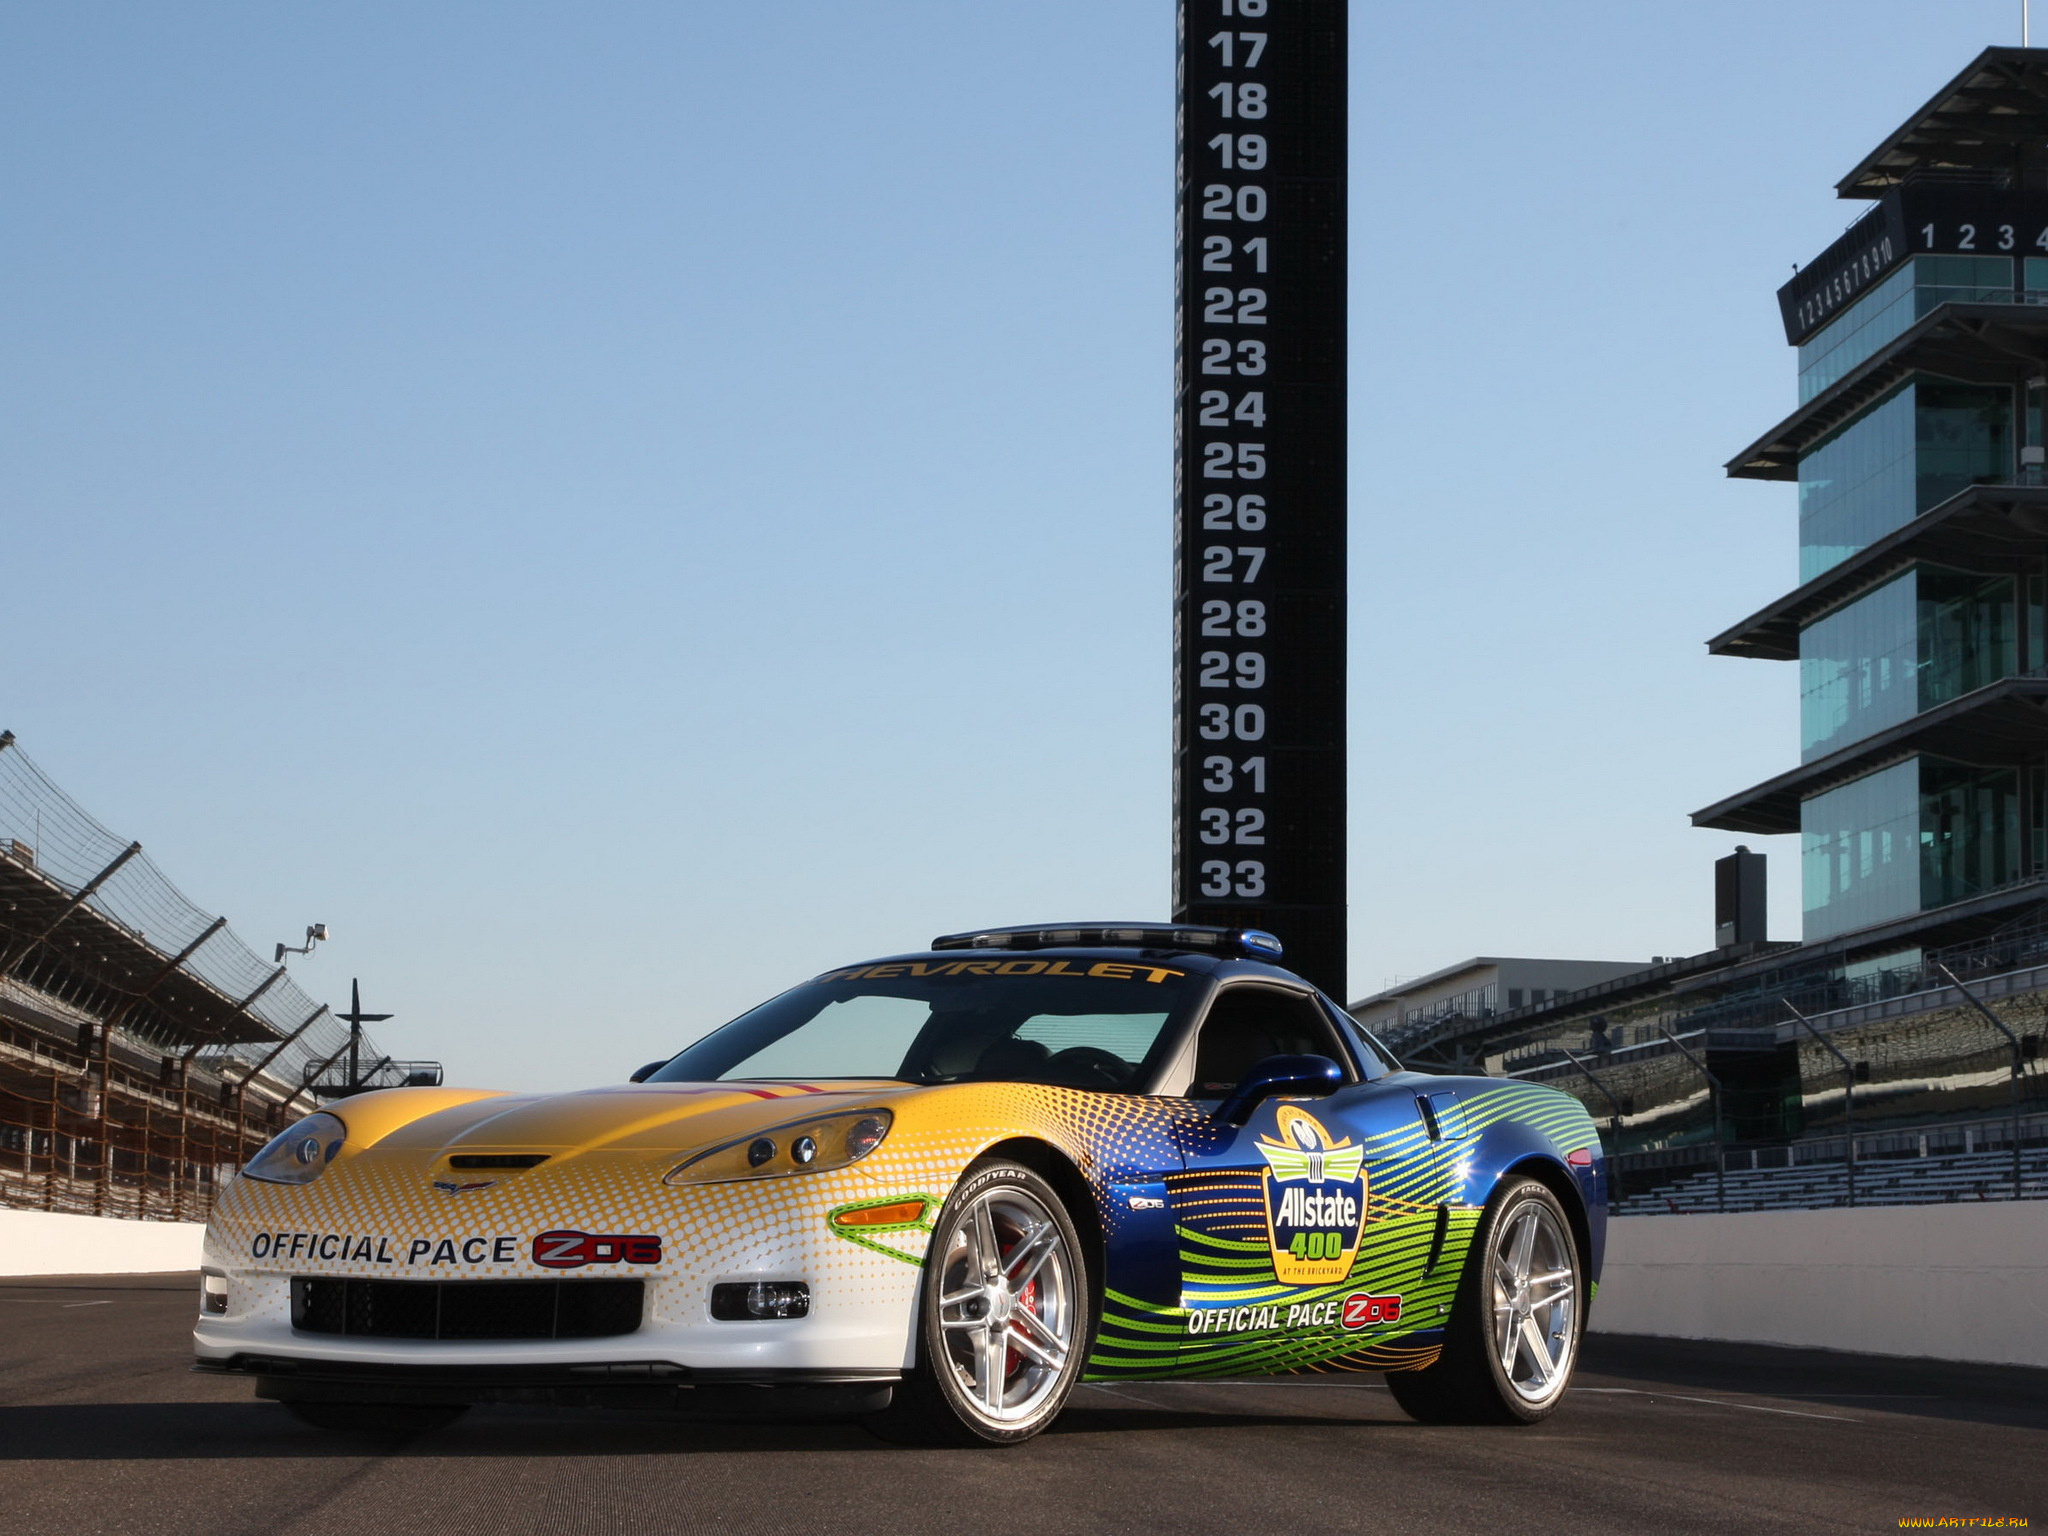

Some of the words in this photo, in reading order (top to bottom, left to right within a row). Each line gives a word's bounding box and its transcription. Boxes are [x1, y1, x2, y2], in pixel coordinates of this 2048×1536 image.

[1208, 31, 1268, 68] 17
[1208, 82, 1268, 119] 18
[1208, 133, 1268, 170] 19
[1203, 184, 1267, 221] 20
[1203, 235, 1267, 272] 21
[1921, 223, 1934, 249] 1
[1958, 224, 1976, 249] 2
[1998, 224, 2014, 250] 3
[1799, 307, 1805, 330] 1
[1807, 301, 1814, 324] 2
[1816, 293, 1823, 316] 3
[1826, 285, 1832, 309] 4
[1834, 278, 1842, 302] 5
[1843, 270, 1851, 294] 6
[1852, 262, 1859, 287] 7
[1862, 254, 1870, 279] 8
[1872, 246, 1880, 271] 9
[1881, 236, 1892, 264] 10
[1204, 287, 1267, 324] 22
[1202, 339, 1267, 376] 23
[1200, 390, 1266, 427] 24
[1203, 442, 1266, 479] 25
[1203, 493, 1266, 531] 26
[1203, 546, 1266, 583] 27
[1201, 600, 1266, 637] 28
[1200, 651, 1266, 688] 29
[1200, 703, 1266, 740] 30
[1203, 755, 1265, 792] 31
[1200, 807, 1265, 844] 32
[1201, 860, 1265, 897] 33
[812, 961, 1185, 984] HEVROLET
[954, 1170, 1027, 1211] GOODYEAR
[1276, 1187, 1356, 1228] Allstate
[252, 1232, 394, 1263] OFFICIAL
[408, 1236, 518, 1265] PACE
[536, 1231, 662, 1266] Z06
[1288, 1232, 1343, 1261] 400
[1188, 1305, 1279, 1334] OFFICIAL
[1286, 1301, 1338, 1328] PACE
[1343, 1293, 1402, 1326] Z06
